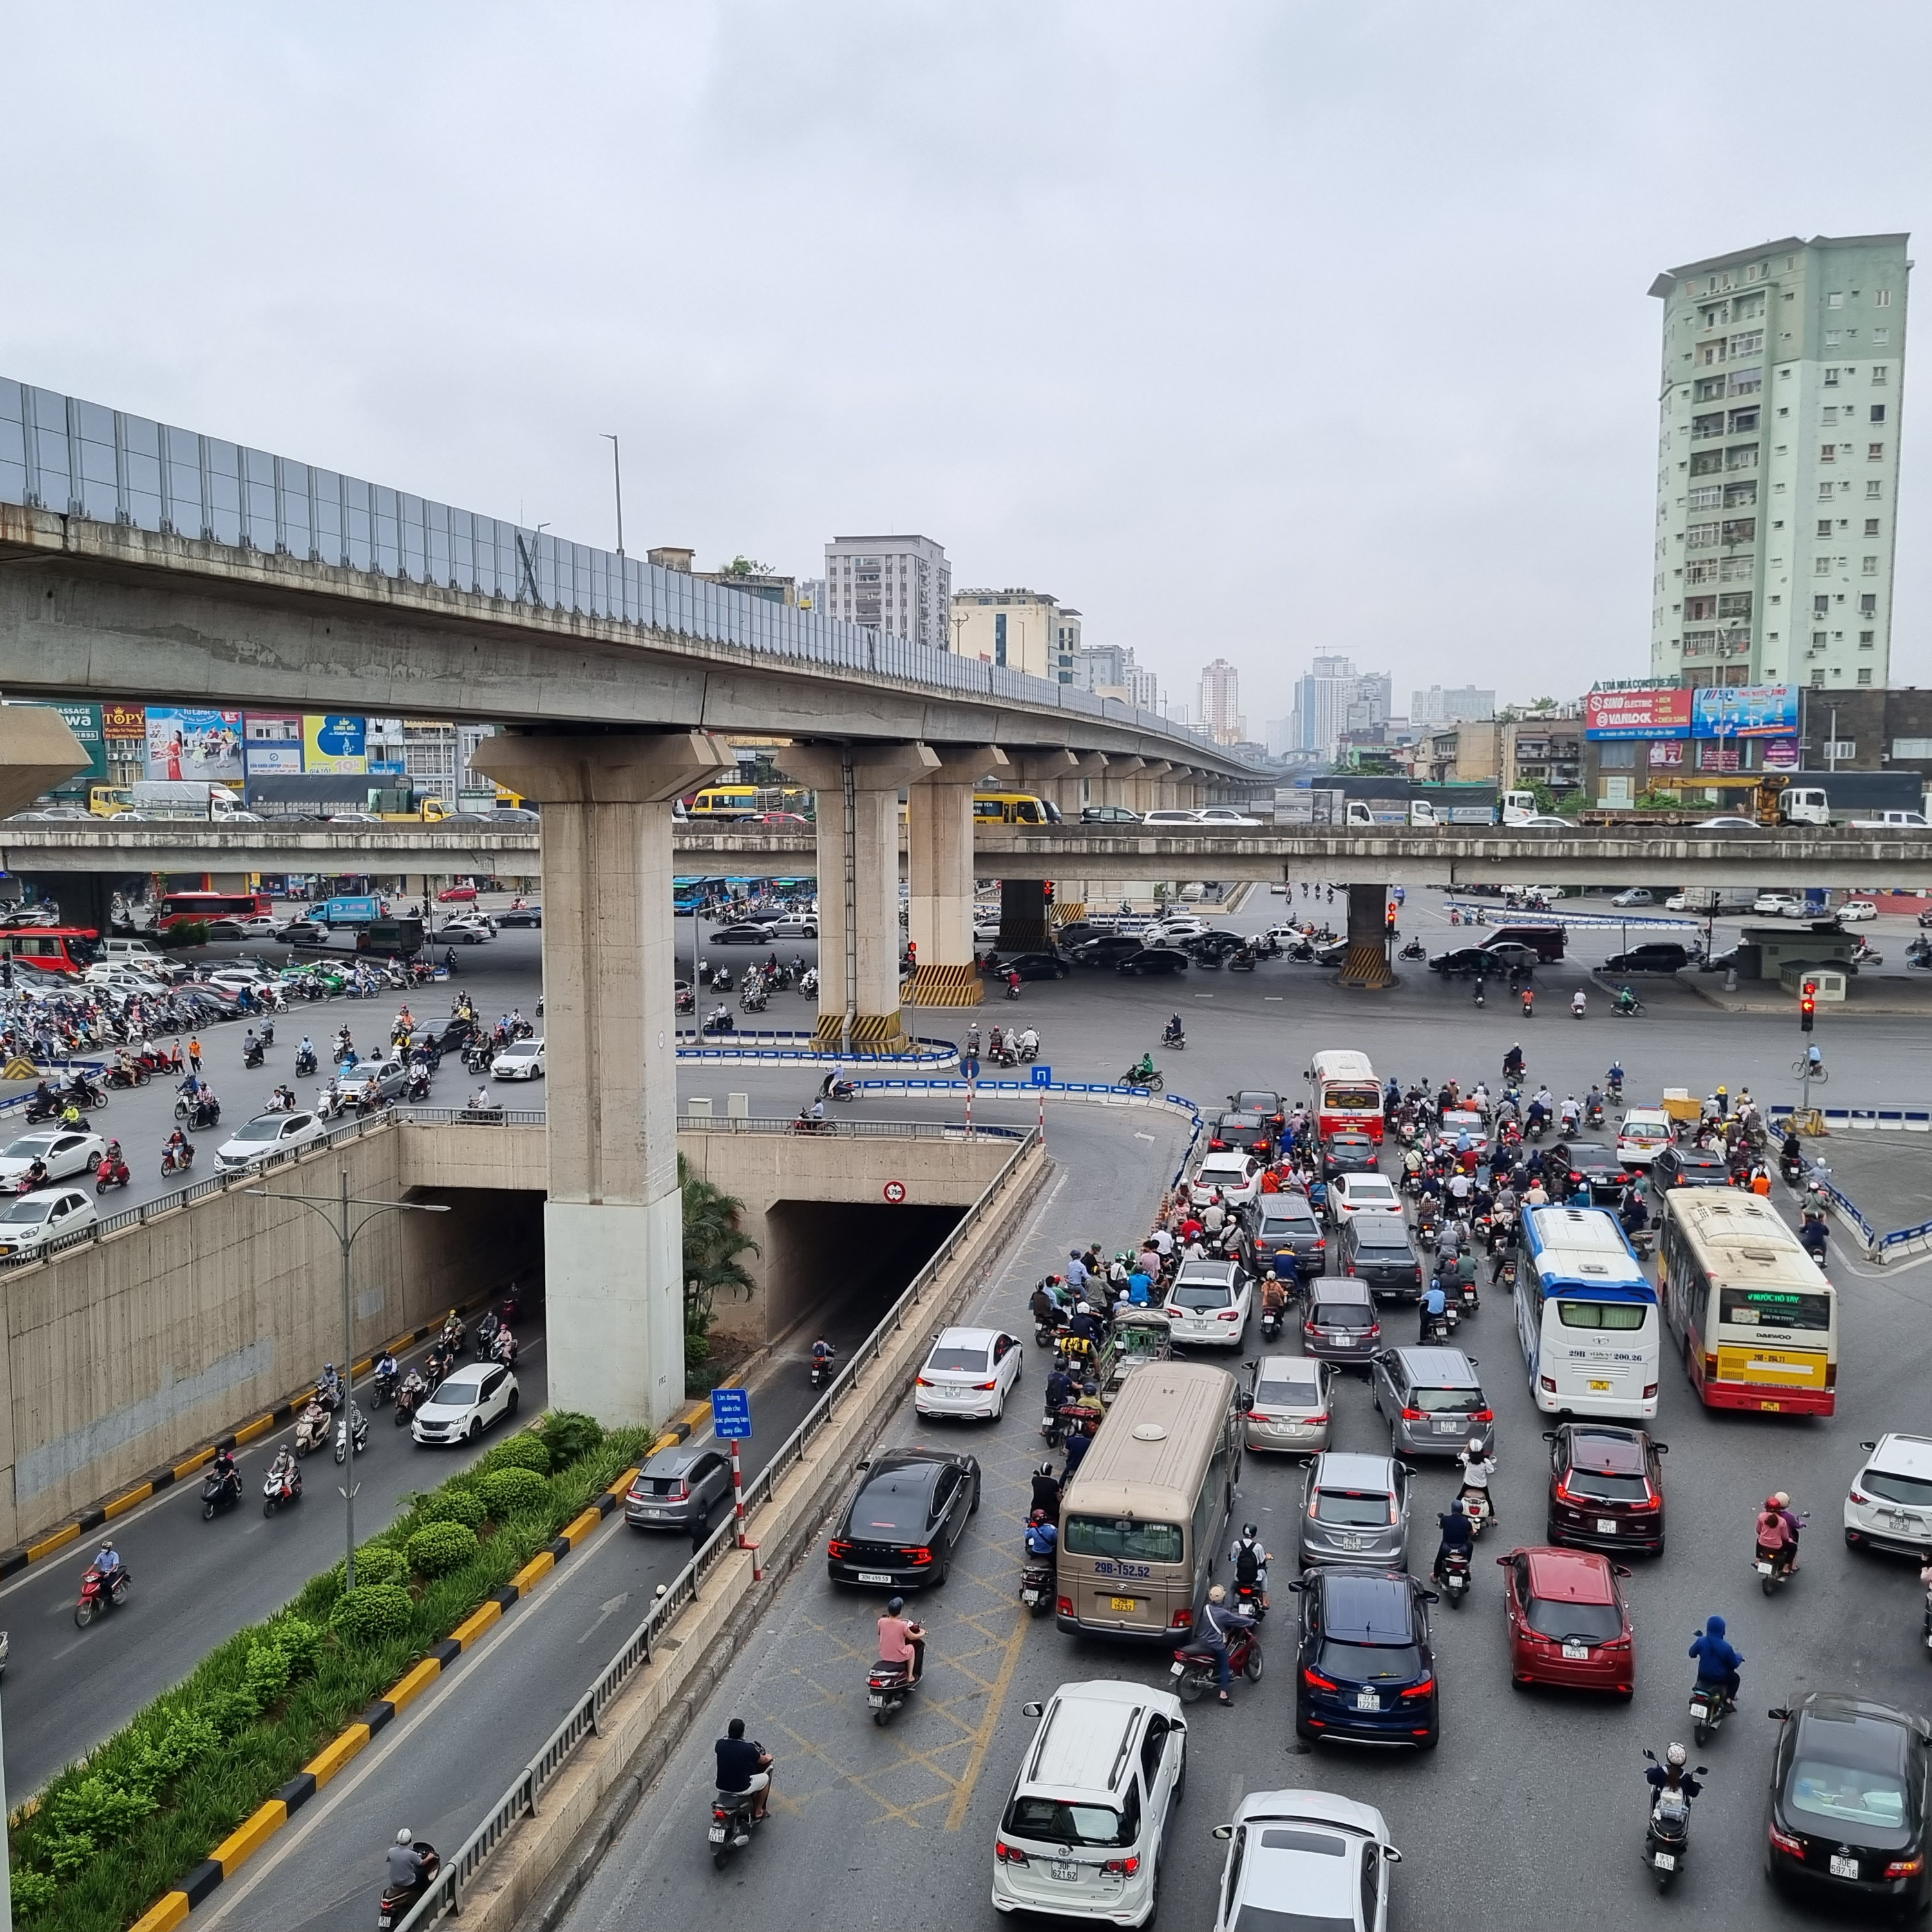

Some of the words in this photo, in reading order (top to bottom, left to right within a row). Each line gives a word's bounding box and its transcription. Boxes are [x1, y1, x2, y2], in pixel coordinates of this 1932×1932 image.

[1603, 697, 1624, 709] SINO
[1624, 699, 1653, 708] ELECTRIC
[104, 714, 145, 724] TOPY
[1609, 712, 1653, 724] VANLOCK
[1613, 1353, 1642, 1361] 200.26
[1095, 1562, 1150, 1577] 29B-152.52
[1058, 1862, 1070, 1870] 30F
[1837, 1857, 1852, 1868] 30E
[1052, 1870, 1076, 1879] 621.62
[1831, 1864, 1857, 1877] 597.16
